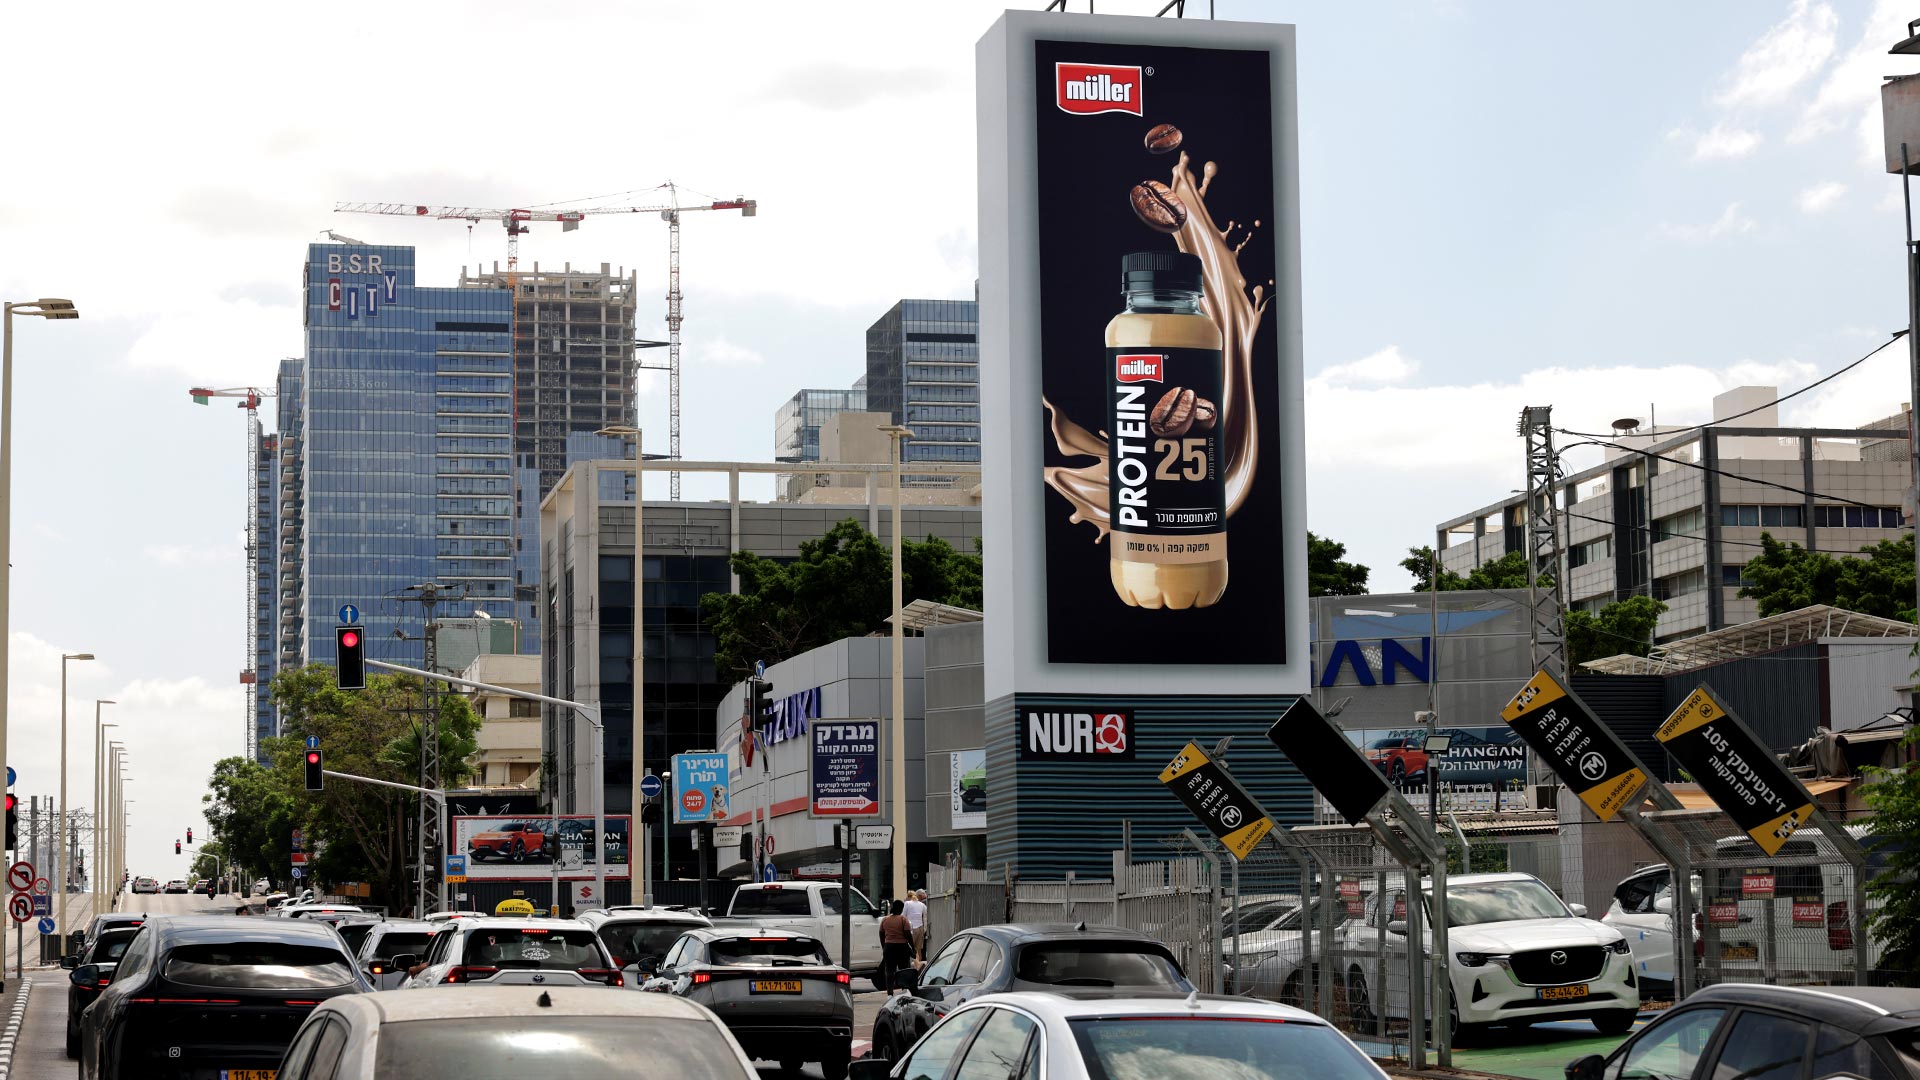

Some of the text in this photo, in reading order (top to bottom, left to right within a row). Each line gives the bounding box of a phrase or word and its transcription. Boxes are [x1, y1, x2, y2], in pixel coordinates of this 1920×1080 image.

[1066, 74, 1133, 102] müller
[328, 254, 382, 274] B.S.R
[330, 275, 396, 316] CITY
[1120, 360, 1157, 375] müller
[1116, 385, 1148, 528] PROTEIN
[1154, 438, 1207, 481] 25
[1155, 511, 1218, 523] ללא תוספת סוכר
[1126, 541, 1145, 552] שומן
[1167, 543, 1184, 554] קפה
[1187, 542, 1210, 553] משקה
[1310, 636, 1436, 687] AN
[1516, 686, 1537, 707] TAXI
[1537, 708, 1557, 730] קניה
[1662, 694, 1702, 737] 054-9566686
[816, 725, 874, 745] מבדק
[1028, 712, 1094, 753] NUR
[1545, 716, 1570, 743] מכירה
[1554, 725, 1583, 756] השכרה
[1702, 725, 1729, 753] 105
[817, 744, 875, 755] פתח תקווה
[1565, 736, 1591, 767] טרייד אין
[682, 758, 724, 770] וטרינר
[1171, 755, 1187, 772] TAXI
[1440, 758, 1523, 771] למי שרוצה הכל
[1187, 772, 1203, 789] קניה
[1193, 778, 1213, 800] מכירה
[1600, 772, 1635, 810] 054-9566686
[1708, 755, 1757, 806] פתח תקווה
[1200, 785, 1223, 809] השכרה
[605, 842, 621, 850] למי
